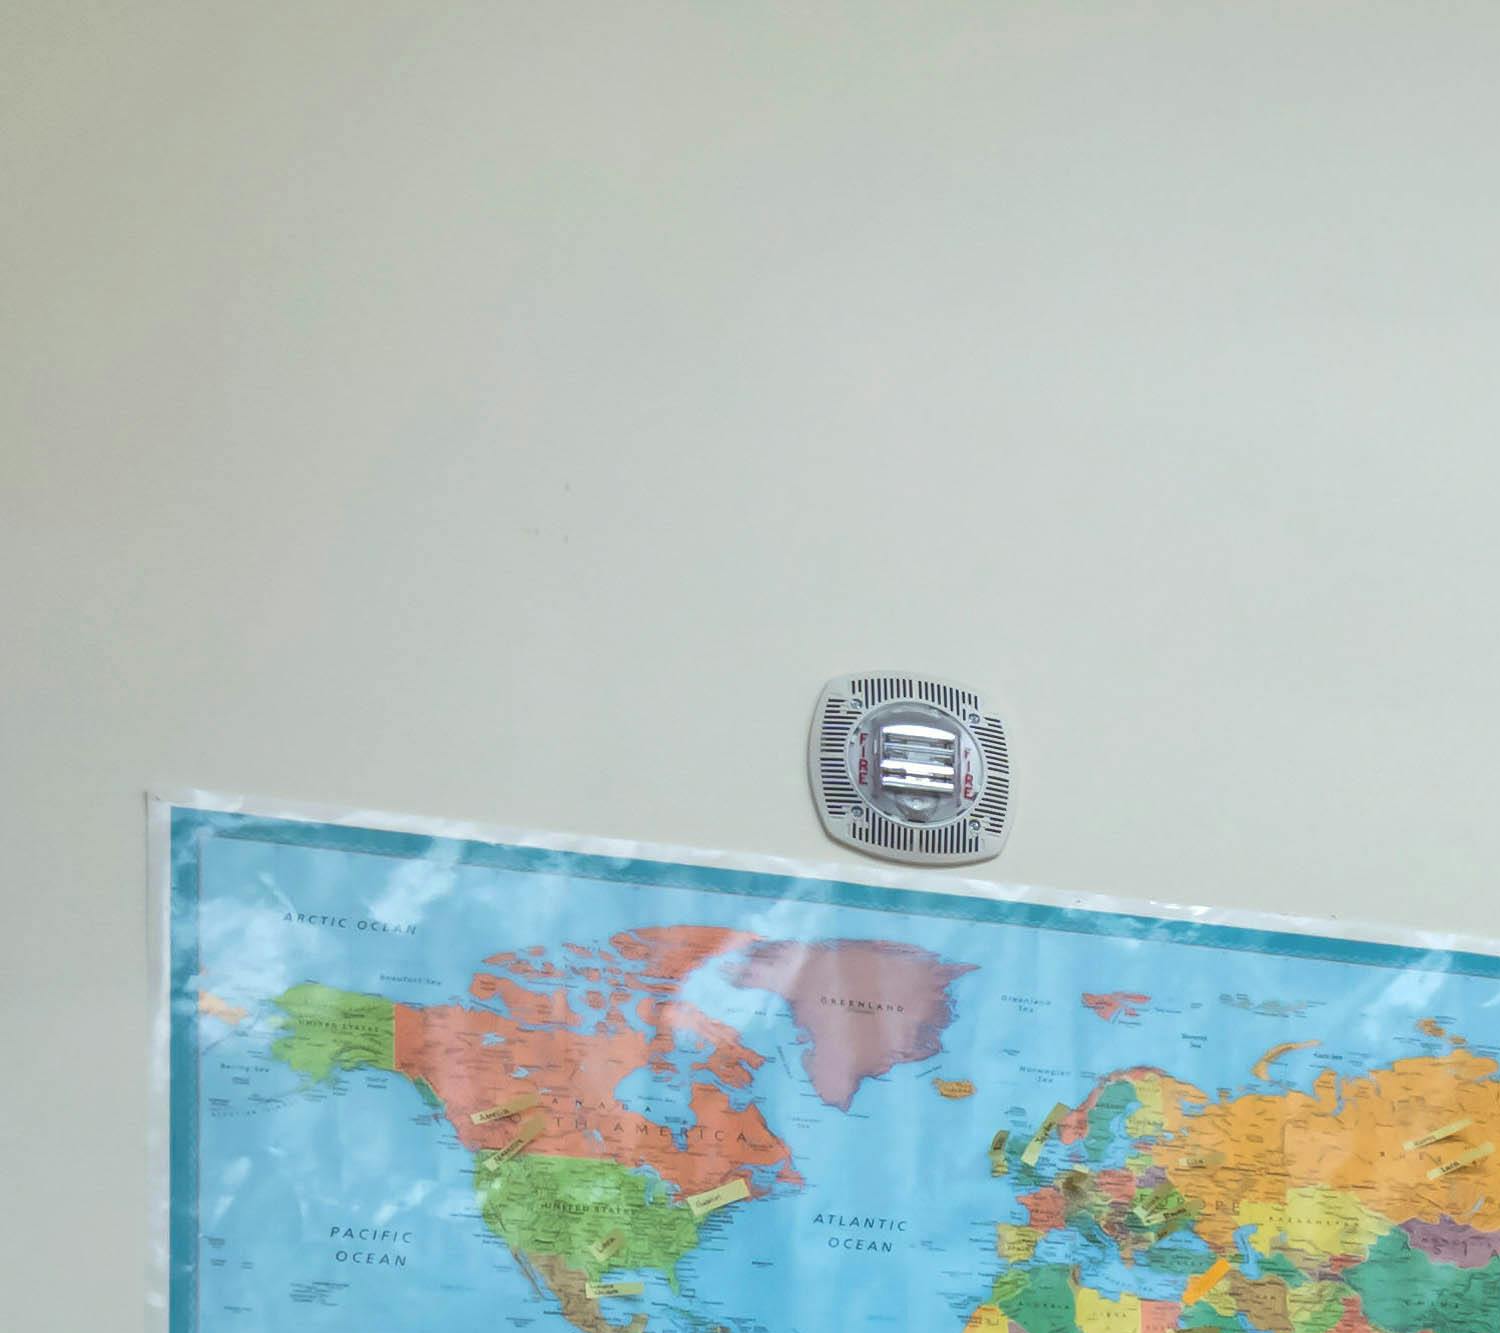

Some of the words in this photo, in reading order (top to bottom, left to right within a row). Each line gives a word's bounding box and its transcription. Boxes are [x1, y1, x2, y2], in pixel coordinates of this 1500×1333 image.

[860, 733, 868, 785] FIRE
[963, 750, 973, 800] FIRE
[283, 912, 346, 928] ARCTIC
[357, 919, 417, 935] OCEAN
[821, 996, 905, 1013] GREENLAND
[613, 1121, 748, 1144] AMERICA
[813, 1213, 908, 1233] ATLANTIC
[330, 1226, 413, 1244] PACIFIC
[828, 1238, 894, 1254] OCEAN
[336, 1250, 407, 1267] OCEAN
